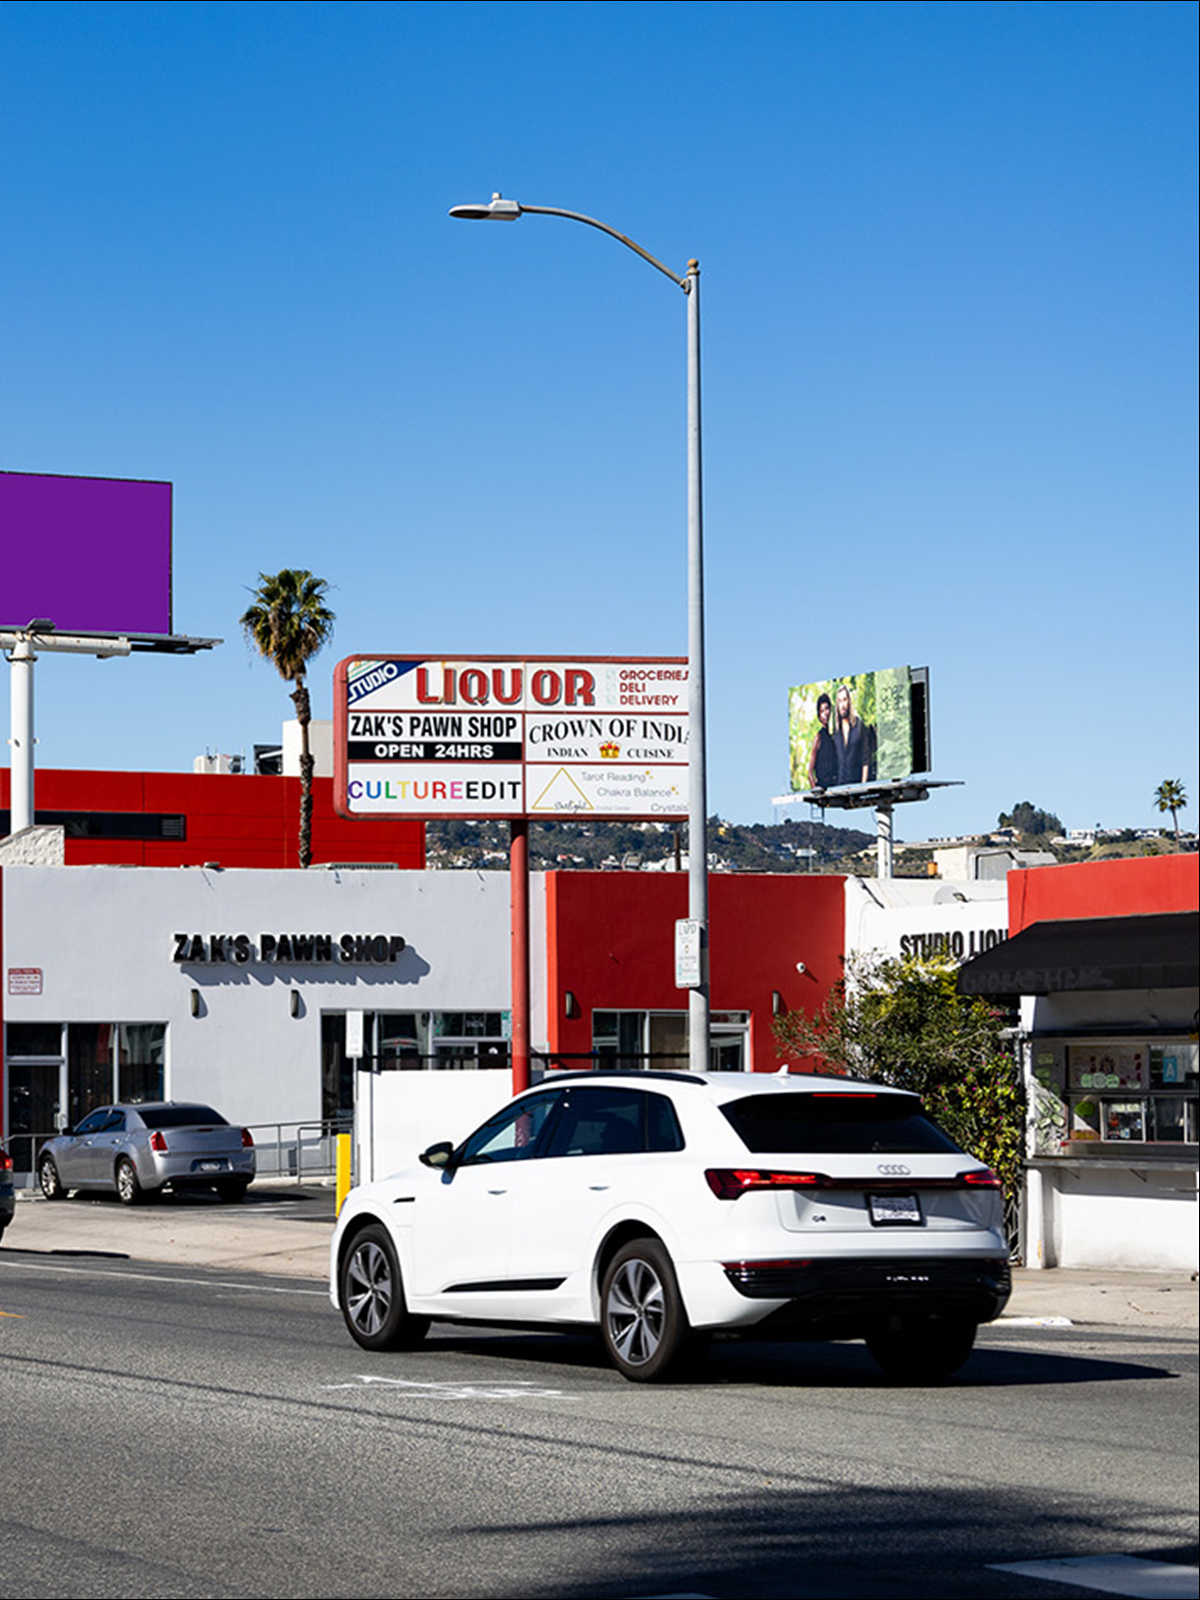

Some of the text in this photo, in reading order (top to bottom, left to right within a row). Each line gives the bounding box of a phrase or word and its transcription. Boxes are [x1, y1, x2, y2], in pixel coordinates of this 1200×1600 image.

[348, 663, 398, 702] STUDIO
[619, 669, 689, 681] GROCERIES
[416, 667, 596, 707] LIQUOR
[619, 682, 646, 693] DELI
[619, 694, 679, 706] DELIVERY
[351, 715, 517, 738] ZAK'S PAWN SHOP
[529, 718, 603, 744] CROWN
[609, 718, 638, 738] OF
[374, 743, 494, 758] OPEN 24HRS
[547, 748, 675, 759] INDIAN CUISINE
[581, 771, 646, 784] Tarot Reading
[349, 780, 522, 800] CULTUREEDIT
[597, 787, 672, 797] Chakra Balance
[650, 803, 689, 813] Crystals
[173, 934, 406, 963] ZAK'S PAWN SHOP
[1165, 1062, 1175, 1078] A
